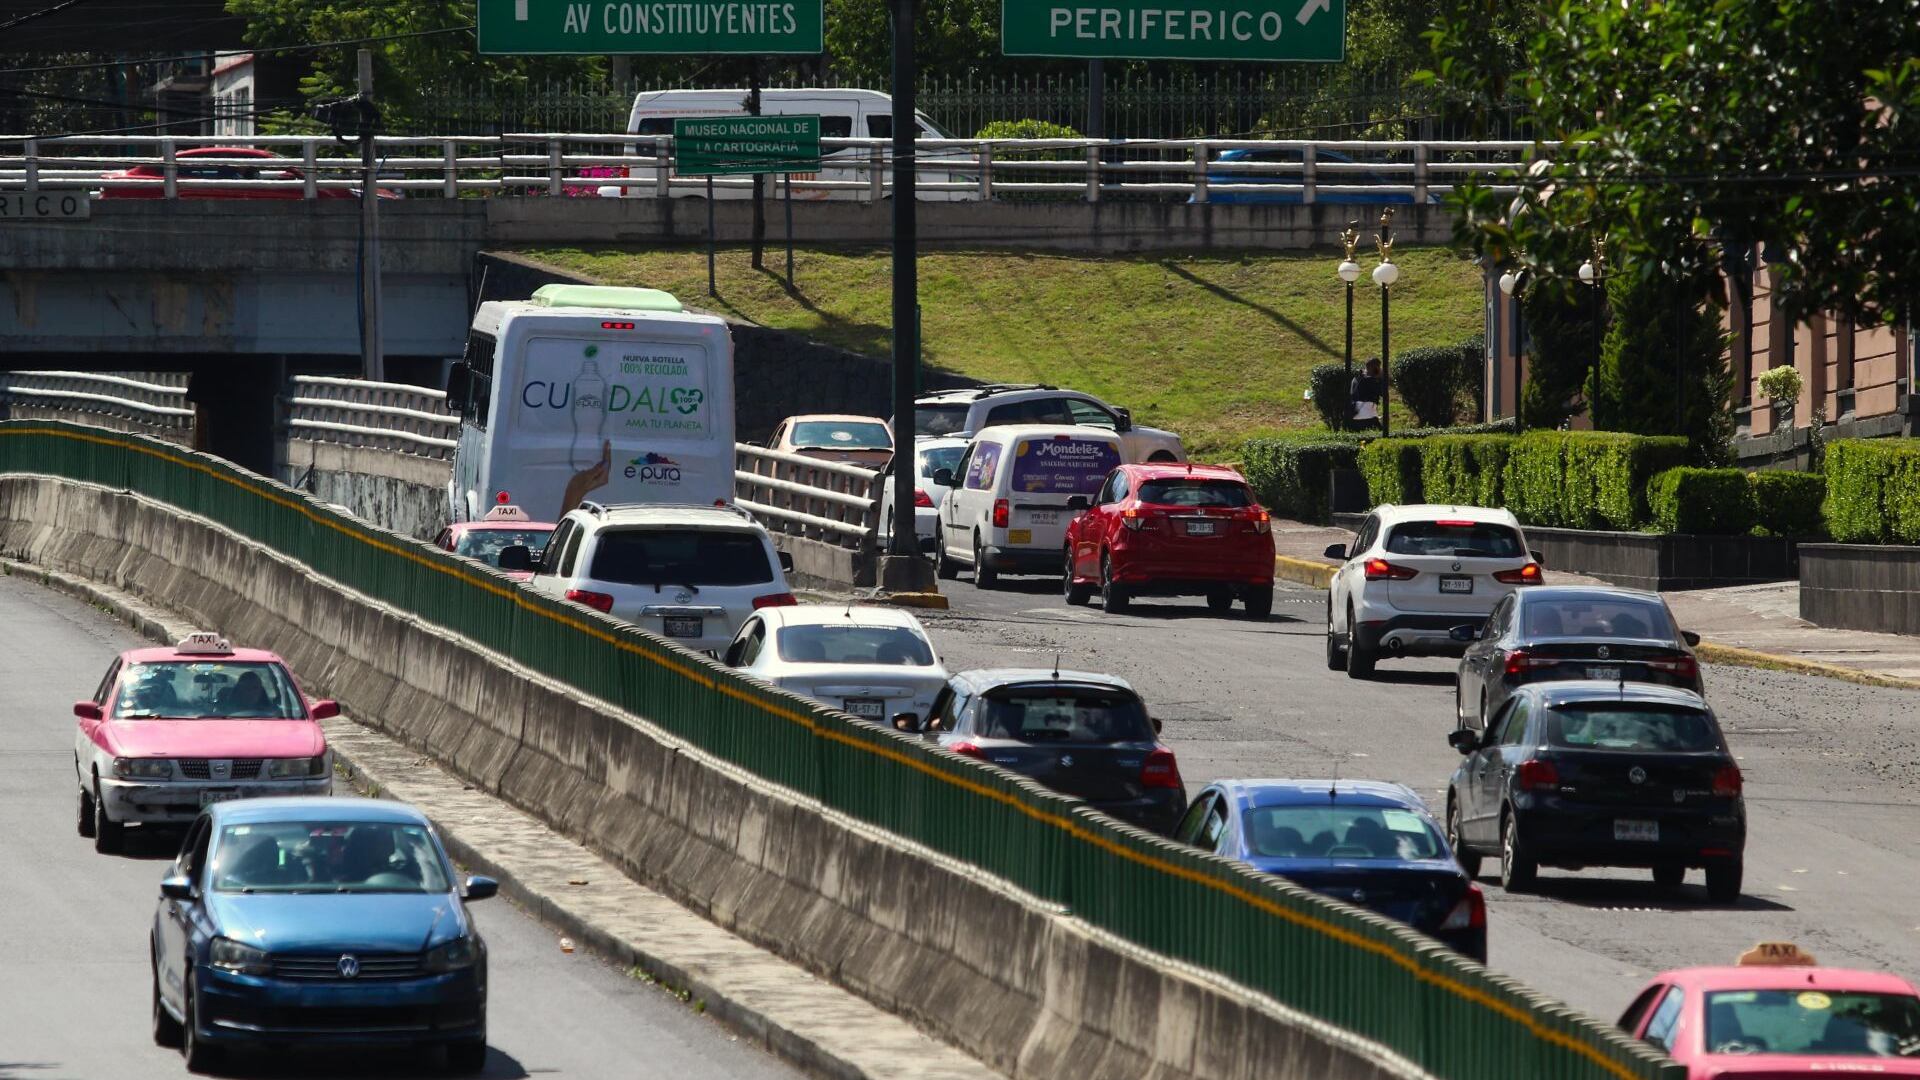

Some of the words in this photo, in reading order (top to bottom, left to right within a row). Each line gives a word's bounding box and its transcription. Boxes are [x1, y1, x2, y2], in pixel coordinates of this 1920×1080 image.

[563, 4, 591, 34] AV
[603, 3, 797, 35] CONSTITUYENTES
[1050, 8, 1283, 41] PERIFERICO
[685, 124, 727, 136] MUSEO
[729, 122, 791, 135] NACIONAL
[793, 122, 809, 134] DE
[696, 143, 711, 153] LA
[622, 355, 650, 363] NUEVA
[652, 356, 685, 364] BOTELLA
[619, 362, 643, 375] 100%
[644, 364, 689, 376] RECICLADA
[624, 419, 648, 428] AMA
[650, 420, 662, 429] TU
[663, 420, 702, 430] PLANETA
[497, 508, 517, 516] TAXI
[192, 635, 215, 645] TAXI
[1759, 943, 1796, 957] TAXI
